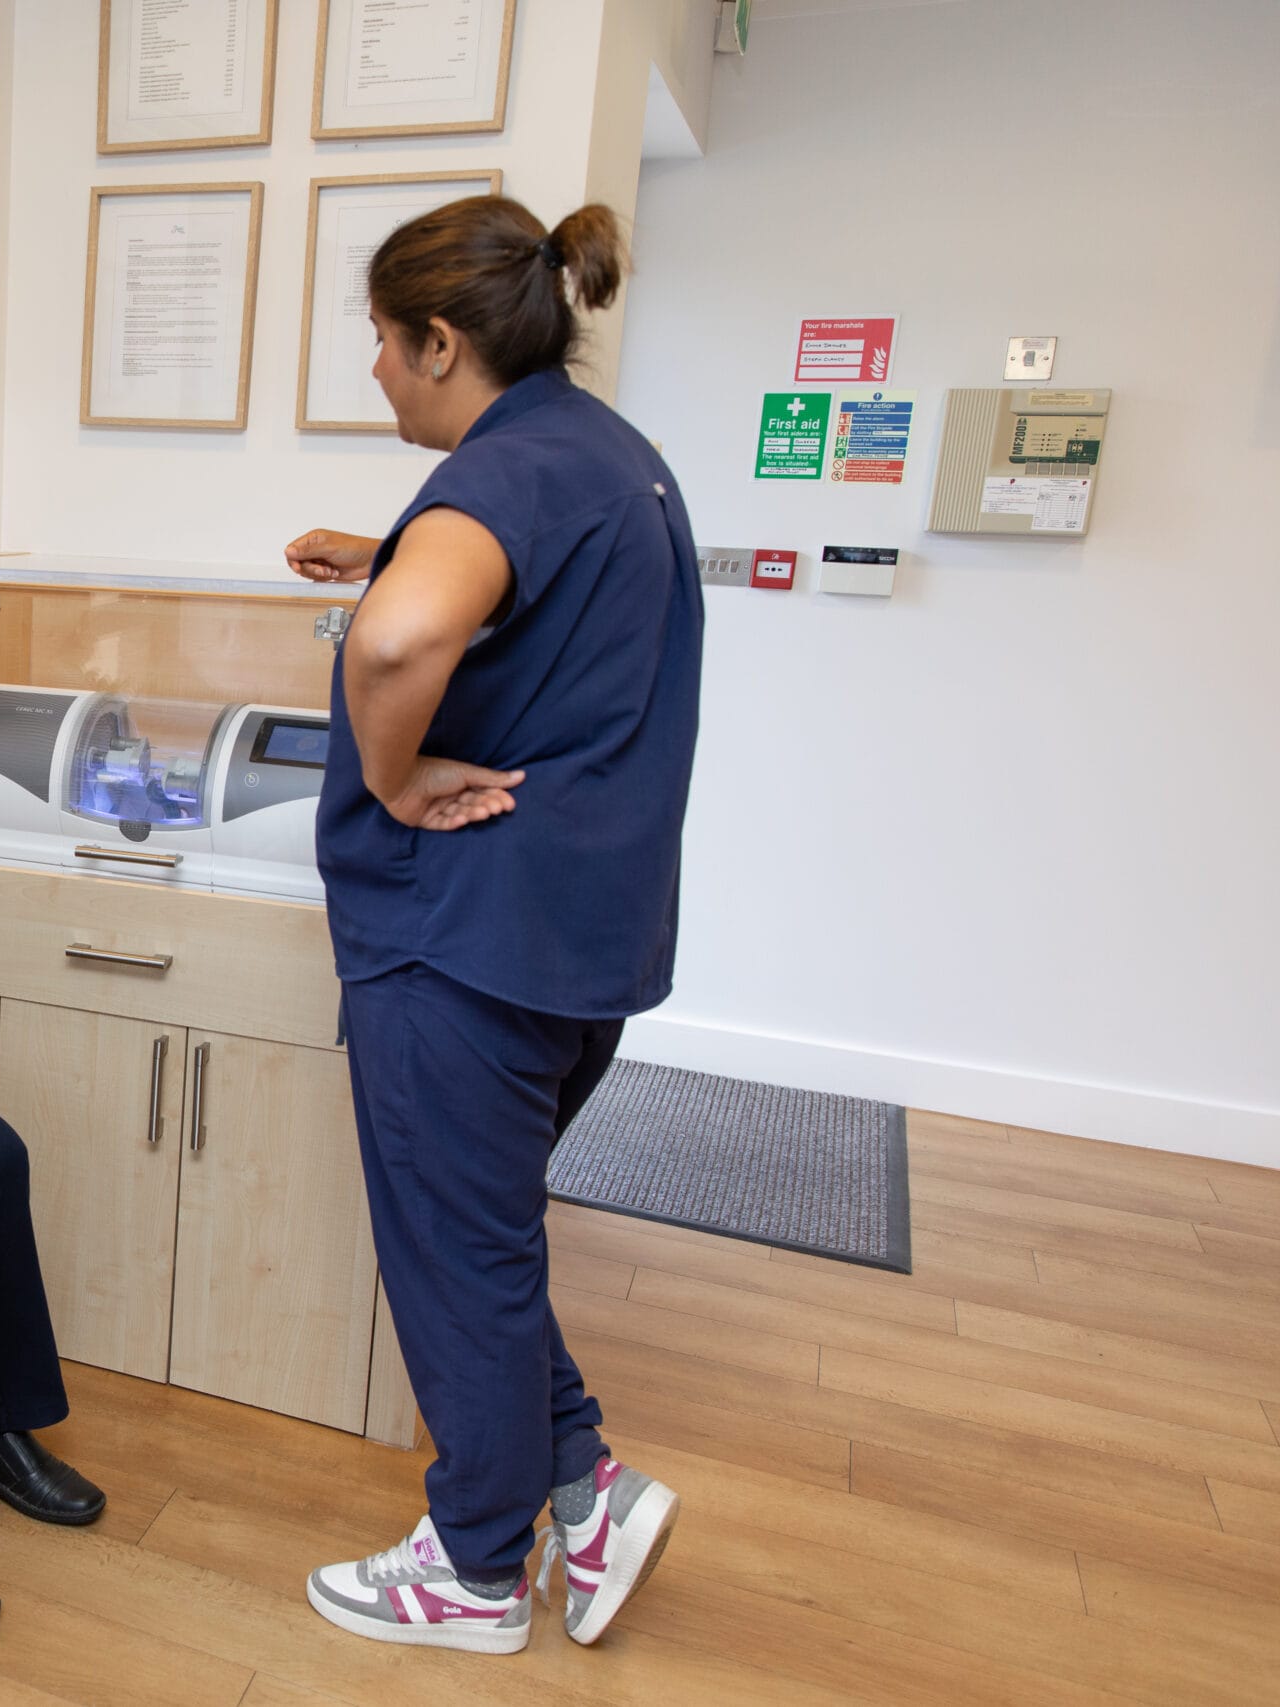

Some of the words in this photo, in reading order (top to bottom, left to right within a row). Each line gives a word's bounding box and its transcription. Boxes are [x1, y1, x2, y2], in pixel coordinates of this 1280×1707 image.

[768, 418, 796, 430] First
[800, 418, 820, 430] aid
[424, 1537, 437, 1561] Gola
[442, 1606, 462, 1615] Gola
